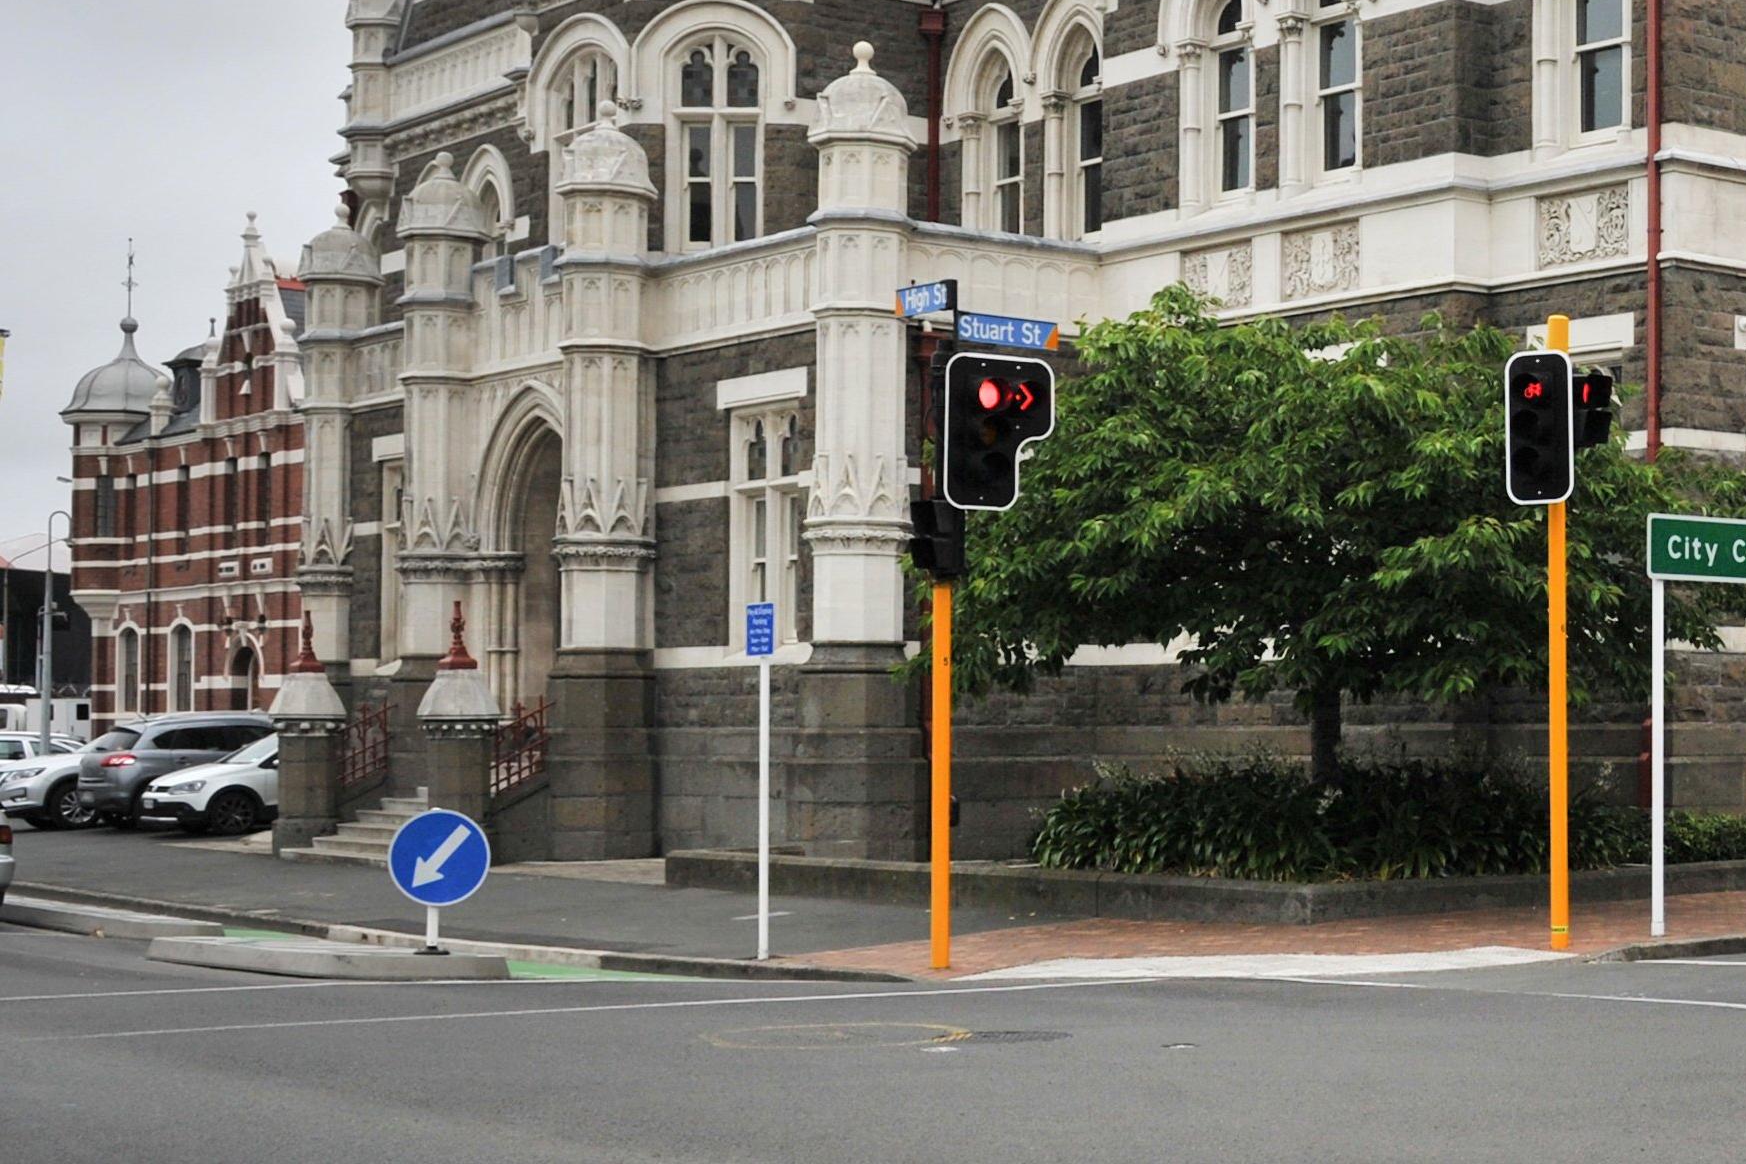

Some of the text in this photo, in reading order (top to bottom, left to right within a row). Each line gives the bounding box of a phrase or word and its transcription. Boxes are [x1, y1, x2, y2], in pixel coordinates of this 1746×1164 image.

[905, 283, 947, 313] High St
[959, 315, 1041, 345] Stuart St
[1667, 535, 1718, 567] City
